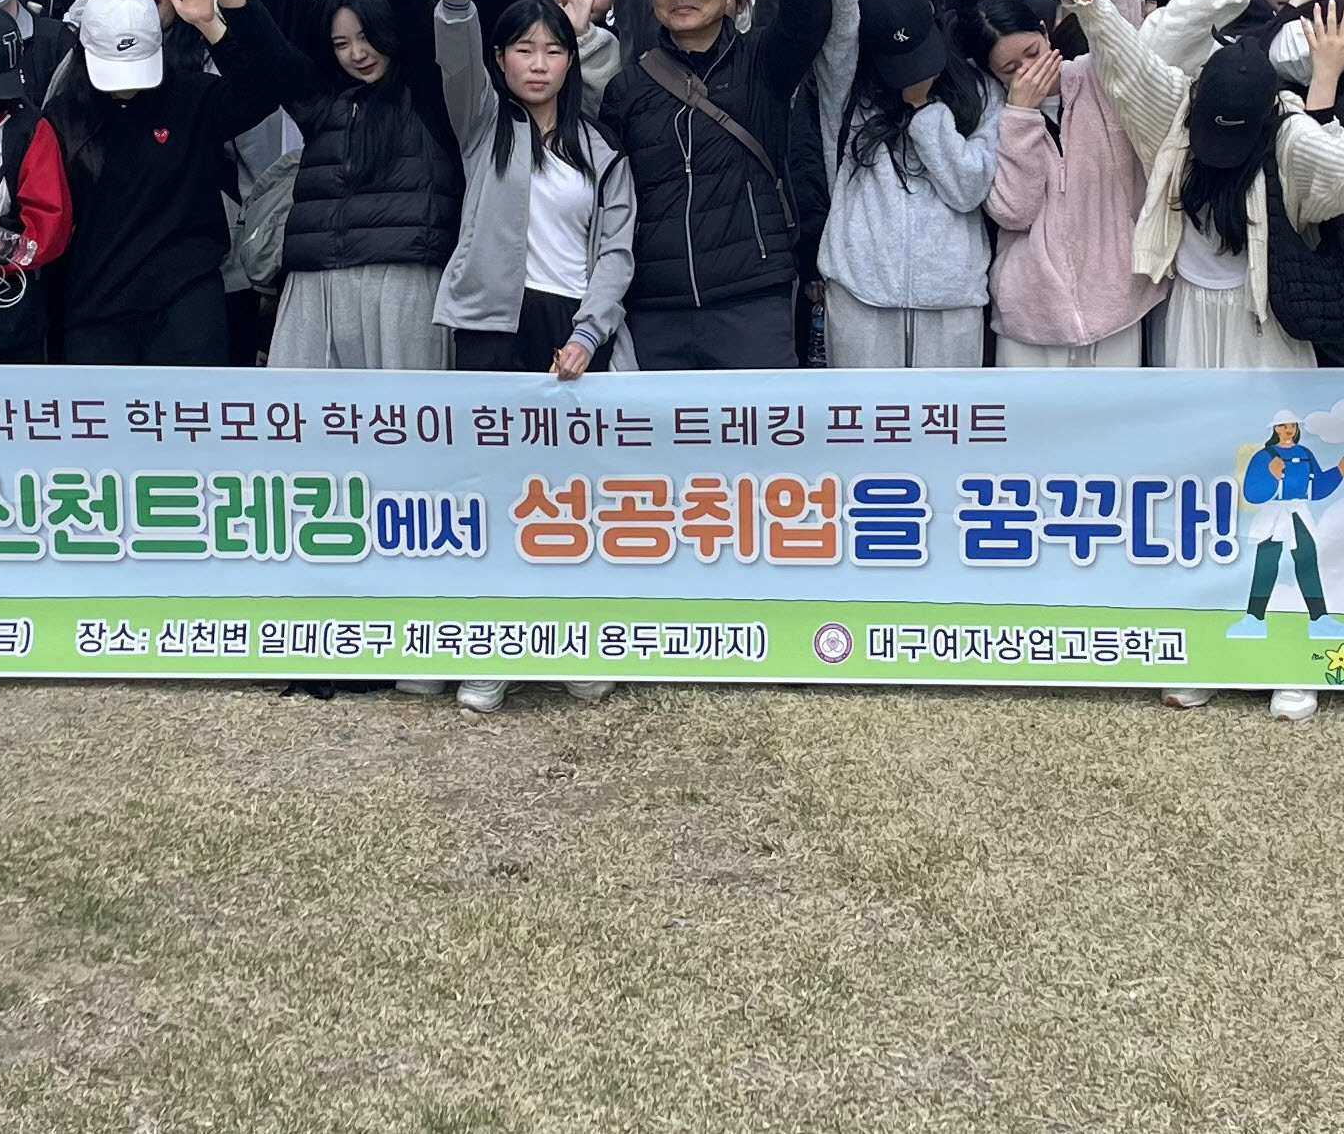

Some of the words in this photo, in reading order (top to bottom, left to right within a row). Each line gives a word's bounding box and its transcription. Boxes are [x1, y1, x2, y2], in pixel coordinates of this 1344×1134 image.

[125, 399, 307, 444] 학부모와
[321, 402, 453, 446] 학생이
[471, 404, 654, 448] 함께하는
[672, 404, 806, 447] 트레킹
[825, 402, 1009, 446] 프로젝트
[513, 477, 925, 560] 성공취업을
[958, 478, 1234, 561] 꿈꾸다!
[77, 622, 148, 654] 장소:
[158, 622, 249, 655] 신천변
[260, 621, 394, 657] 일대(중구
[404, 622, 588, 658] 체육광장에서
[599, 624, 767, 660] 용두교까지)
[868, 626, 1186, 664] 대구여자상업고등학교
